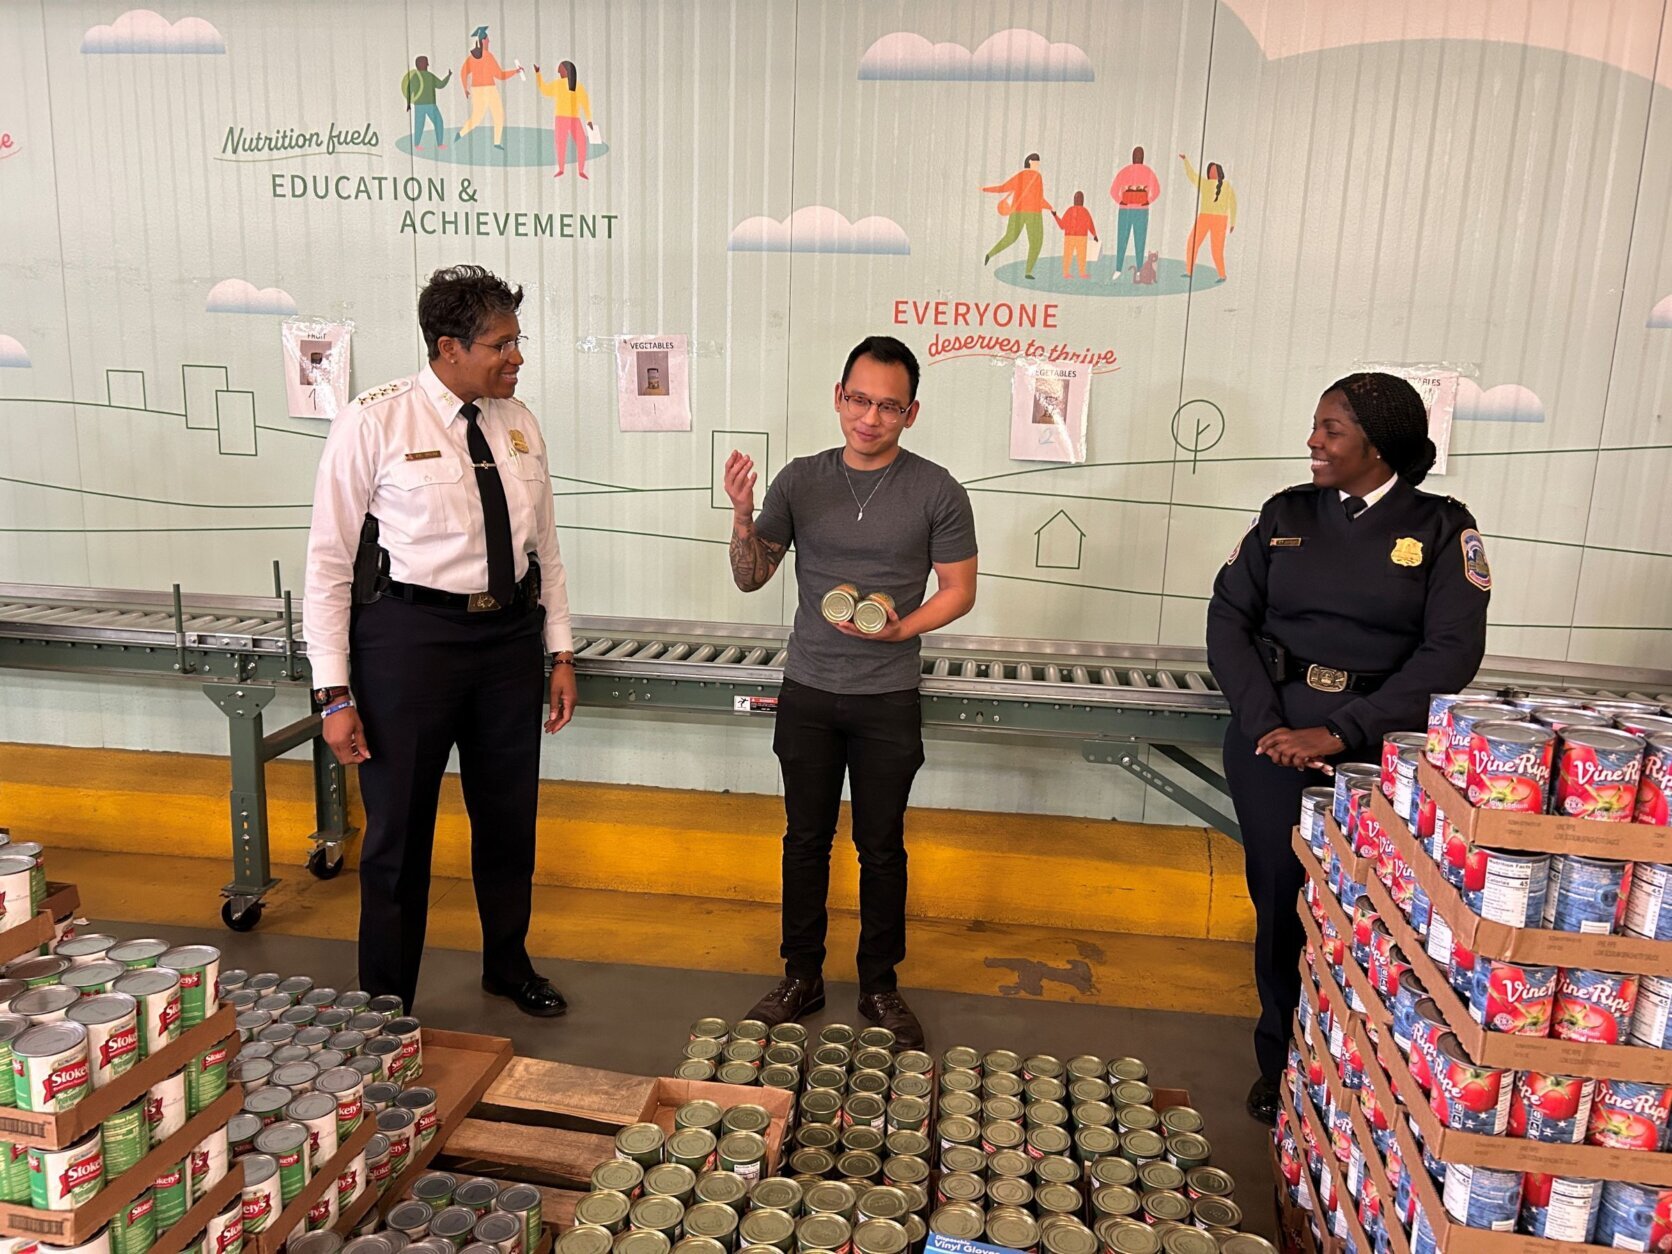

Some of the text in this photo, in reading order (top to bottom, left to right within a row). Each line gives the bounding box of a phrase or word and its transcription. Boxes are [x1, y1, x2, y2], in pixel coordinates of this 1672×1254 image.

[222, 122, 380, 155] Nutrition fuels
[271, 173, 478, 203] EDUCATION &
[399, 209, 619, 240] ACHIEVEMENT
[893, 300, 1059, 328] EVERYONE
[629, 341, 674, 350] VEGETABLES
[928, 333, 1117, 366] deserves to thrive
[1038, 427, 1055, 445] 2
[1473, 750, 1516, 775] Vine
[1573, 760, 1624, 785] Vine
[1502, 979, 1546, 1003] Vine
[1590, 983, 1631, 1013] Ripe
[1434, 1055, 1462, 1097] Ripe
[934, 1239, 961, 1251] Vinyl
